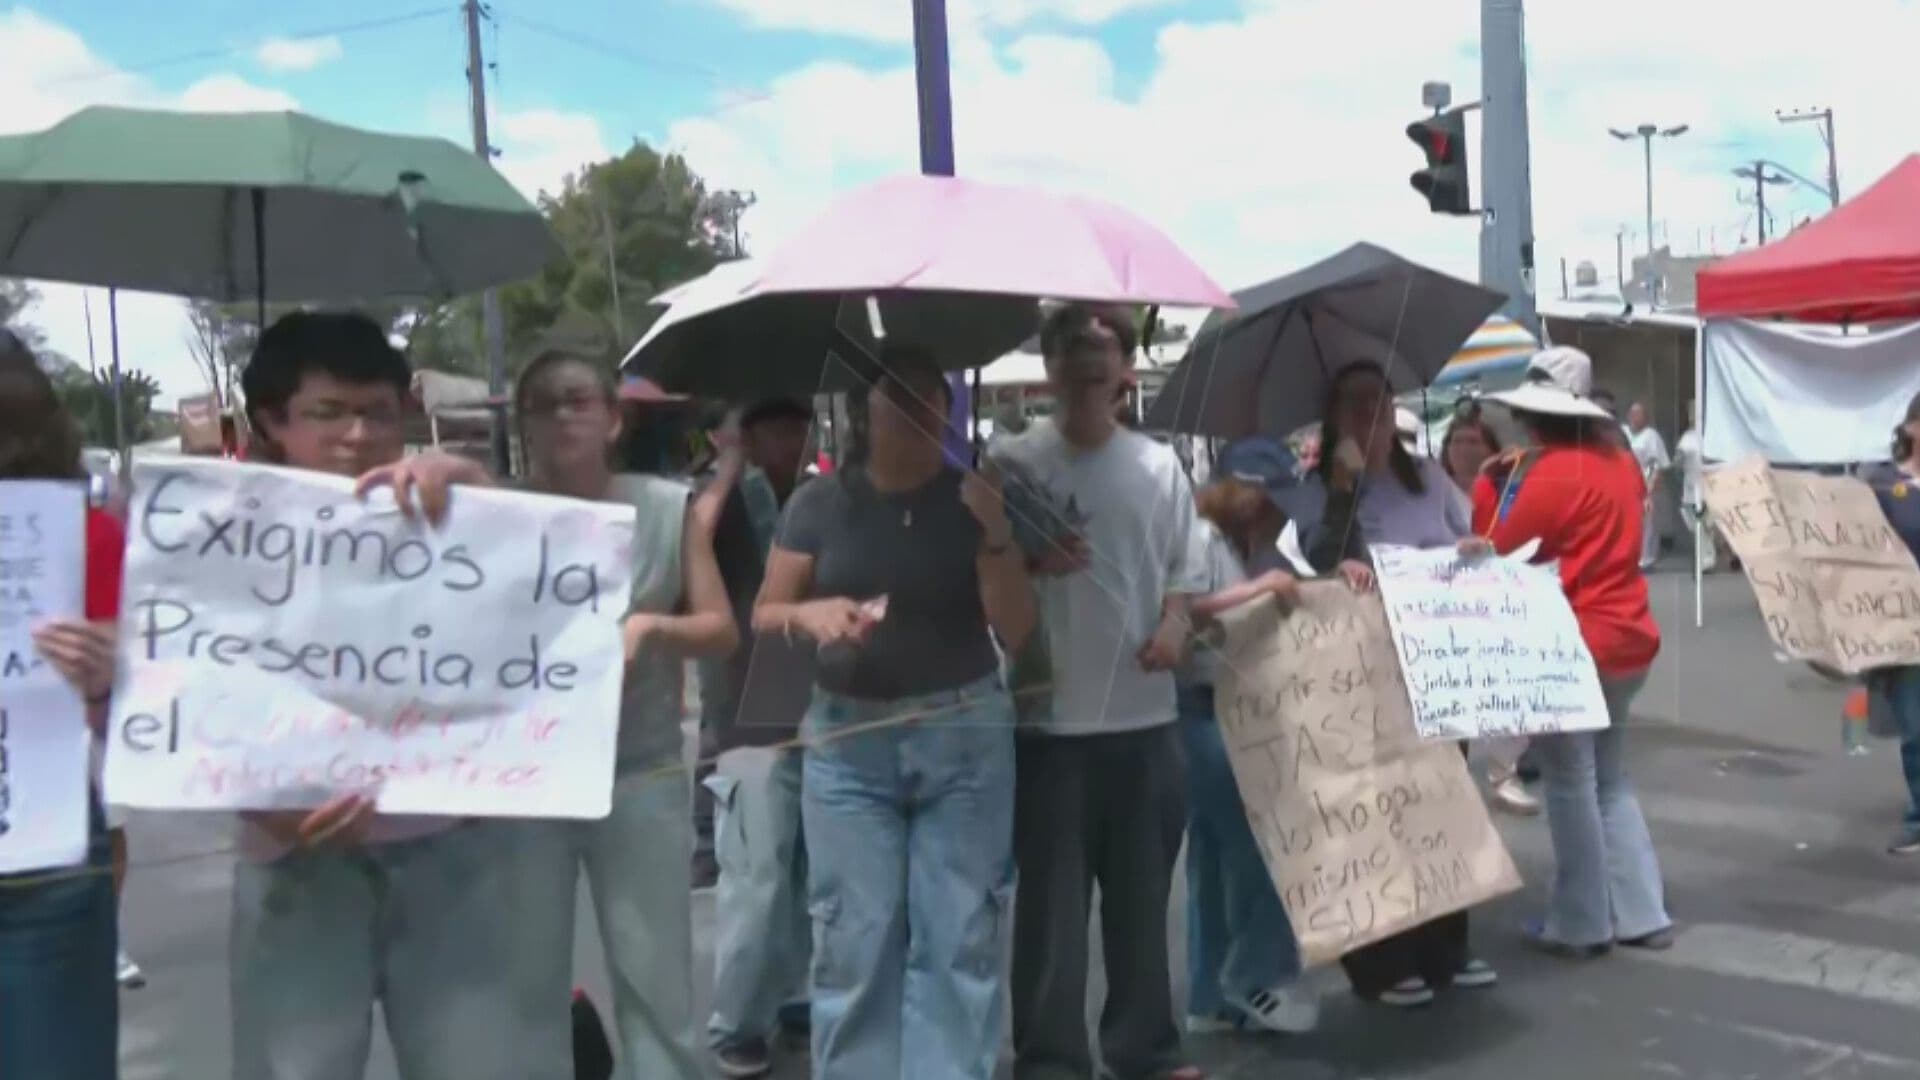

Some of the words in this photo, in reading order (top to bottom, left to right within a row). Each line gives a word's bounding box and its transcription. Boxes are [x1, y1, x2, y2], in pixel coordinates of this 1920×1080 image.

[142, 476, 484, 606] Exigimos
[532, 534, 601, 612] la
[136, 599, 472, 689] Presencia
[499, 634, 578, 691] de
[121, 698, 179, 753] el
